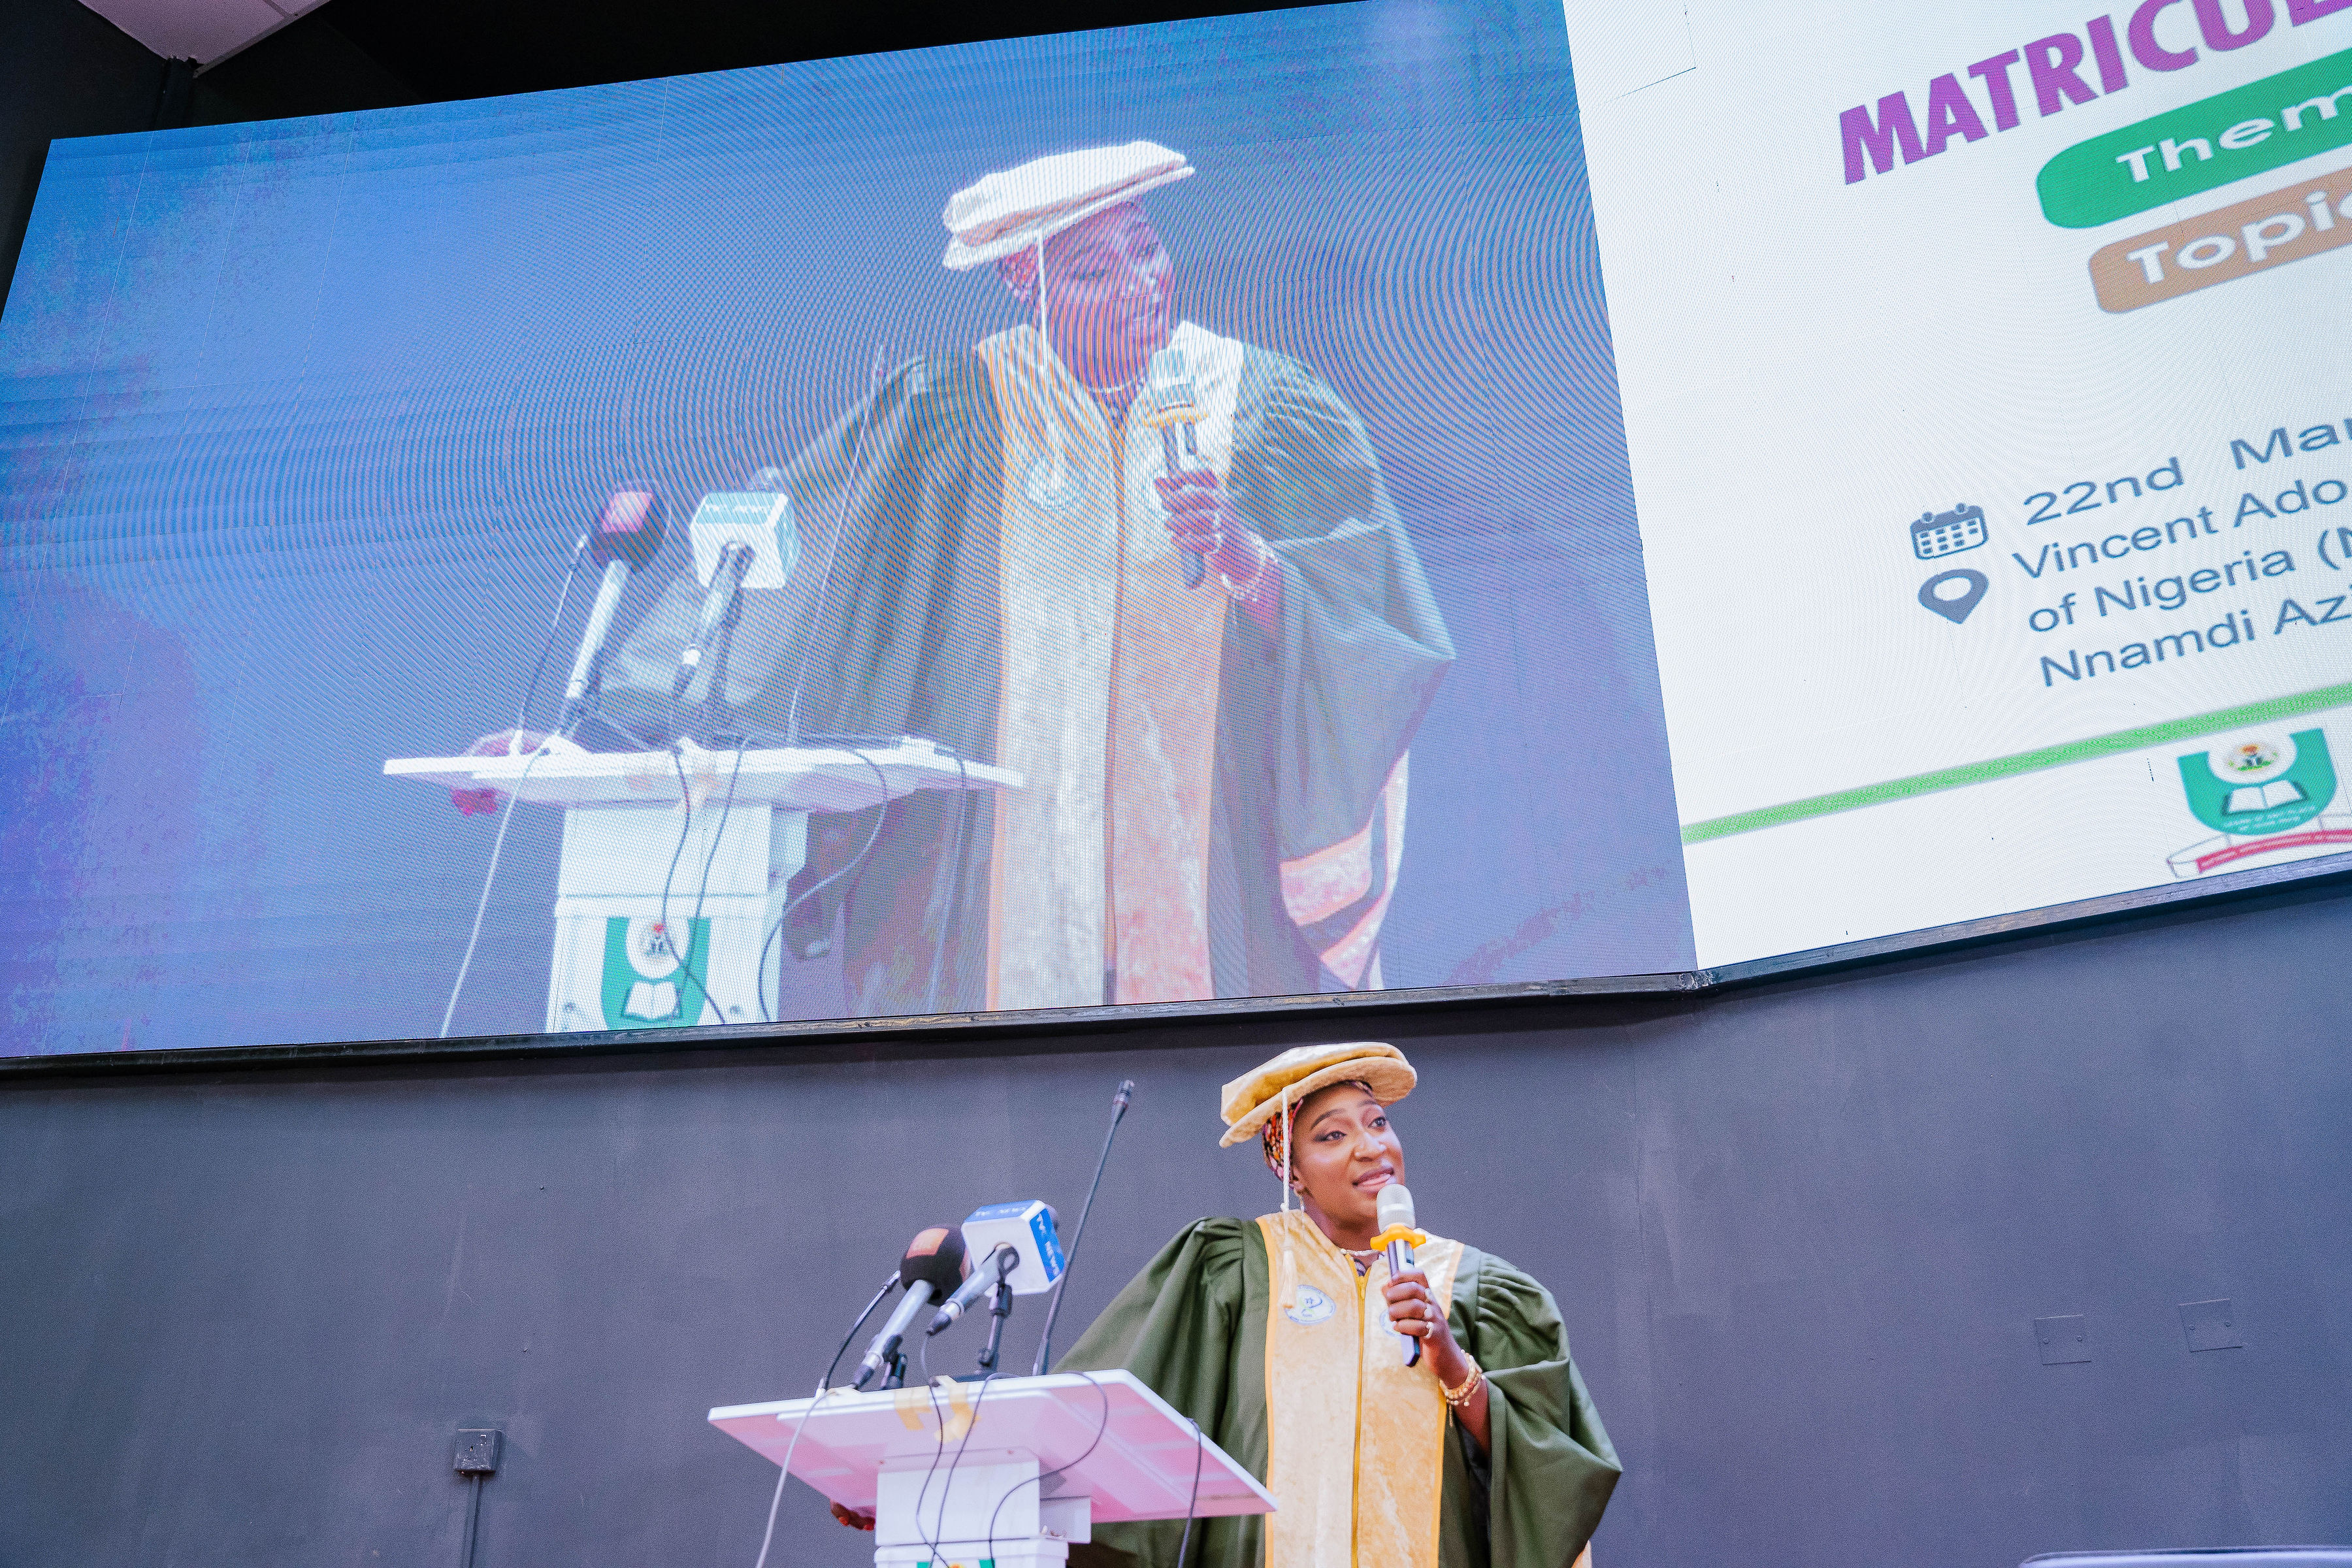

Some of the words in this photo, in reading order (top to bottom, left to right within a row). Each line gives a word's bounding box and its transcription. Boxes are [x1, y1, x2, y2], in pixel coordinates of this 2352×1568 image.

[2127, 190, 2352, 284] Topi
[2012, 506, 2219, 578] Vincent
[2233, 479, 2348, 528] Ado
[2023, 457, 2183, 525] 22nd
[2029, 593, 2076, 632] of
[2094, 550, 2296, 617] Nigeria
[2040, 609, 2255, 687] Nnamdi
[2274, 583, 2352, 635] Az
